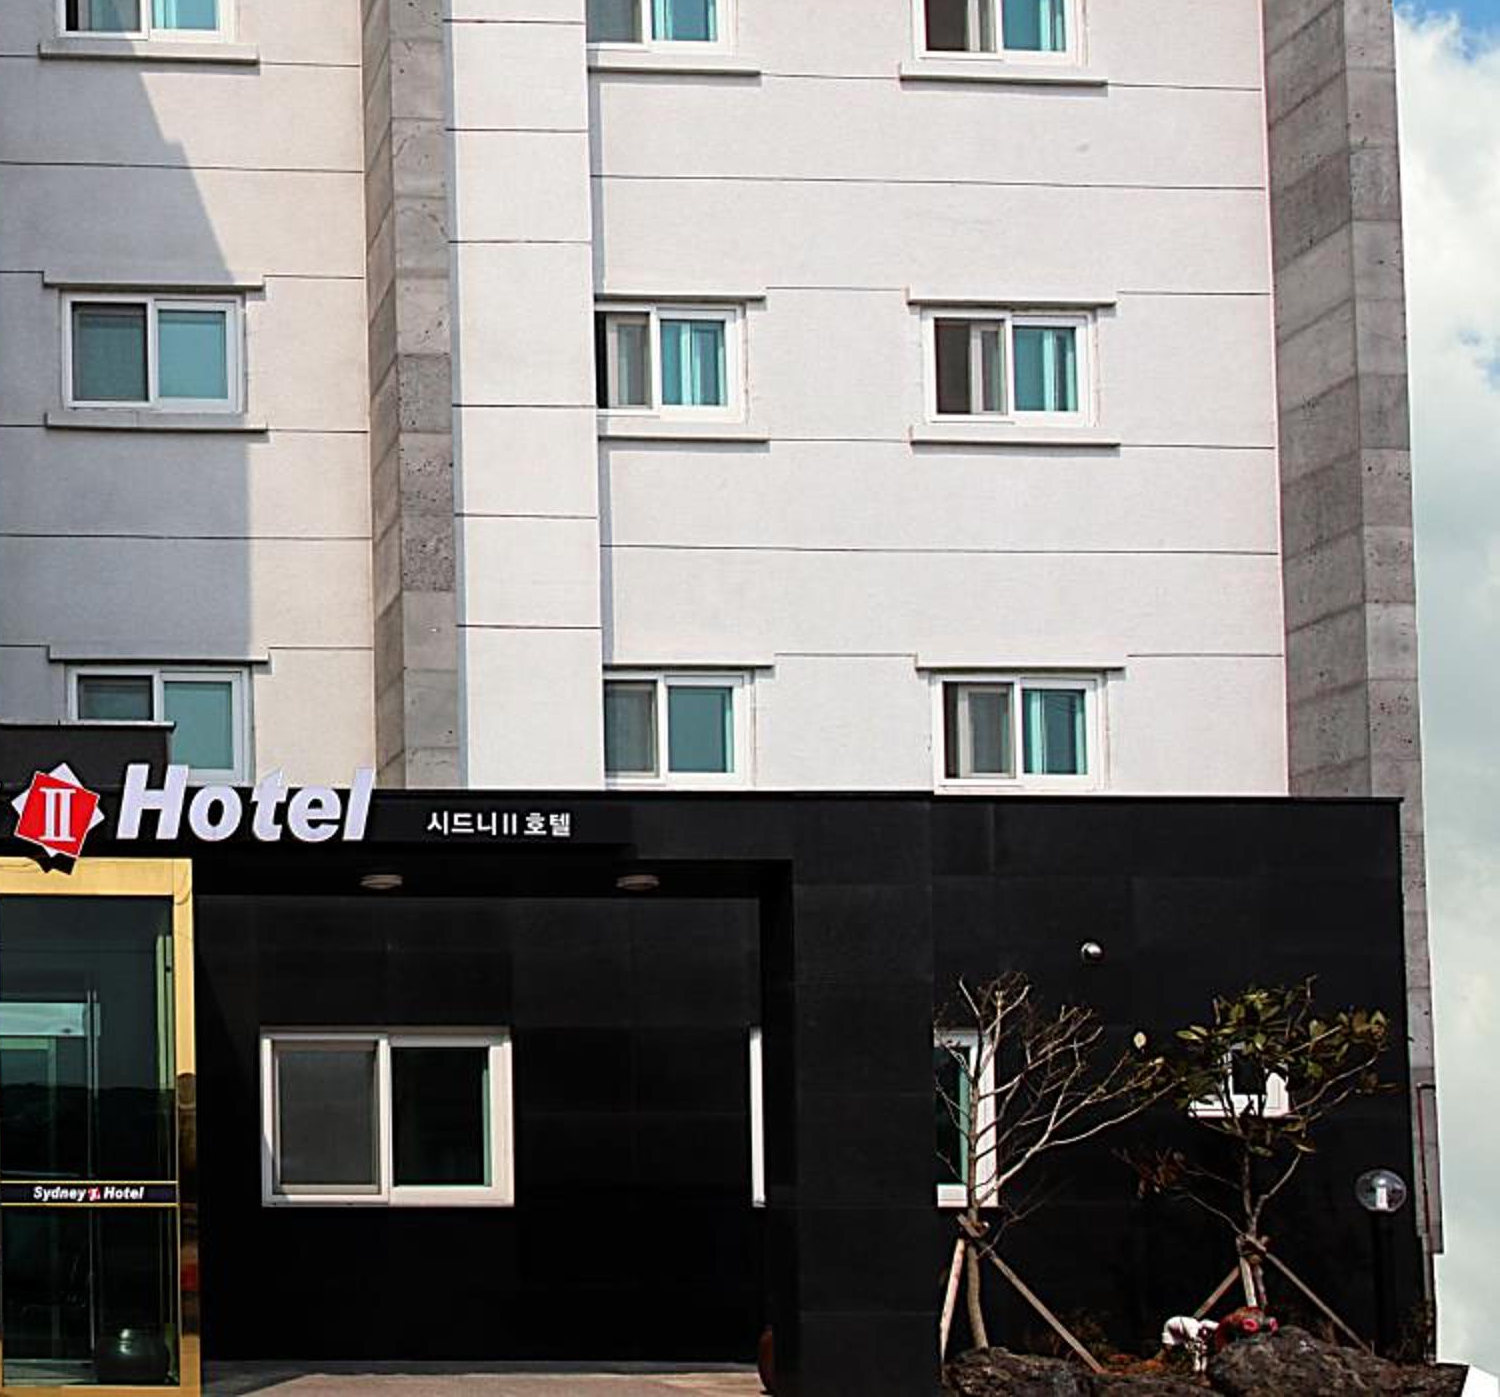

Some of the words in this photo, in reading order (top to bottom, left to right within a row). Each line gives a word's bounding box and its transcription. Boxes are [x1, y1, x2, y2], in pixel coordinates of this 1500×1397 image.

[116, 763, 376, 843] Hotel
[523, 811, 571, 837] 호텔
[33, 1186, 87, 1202] Sydney
[103, 1186, 145, 1200] Hotel
